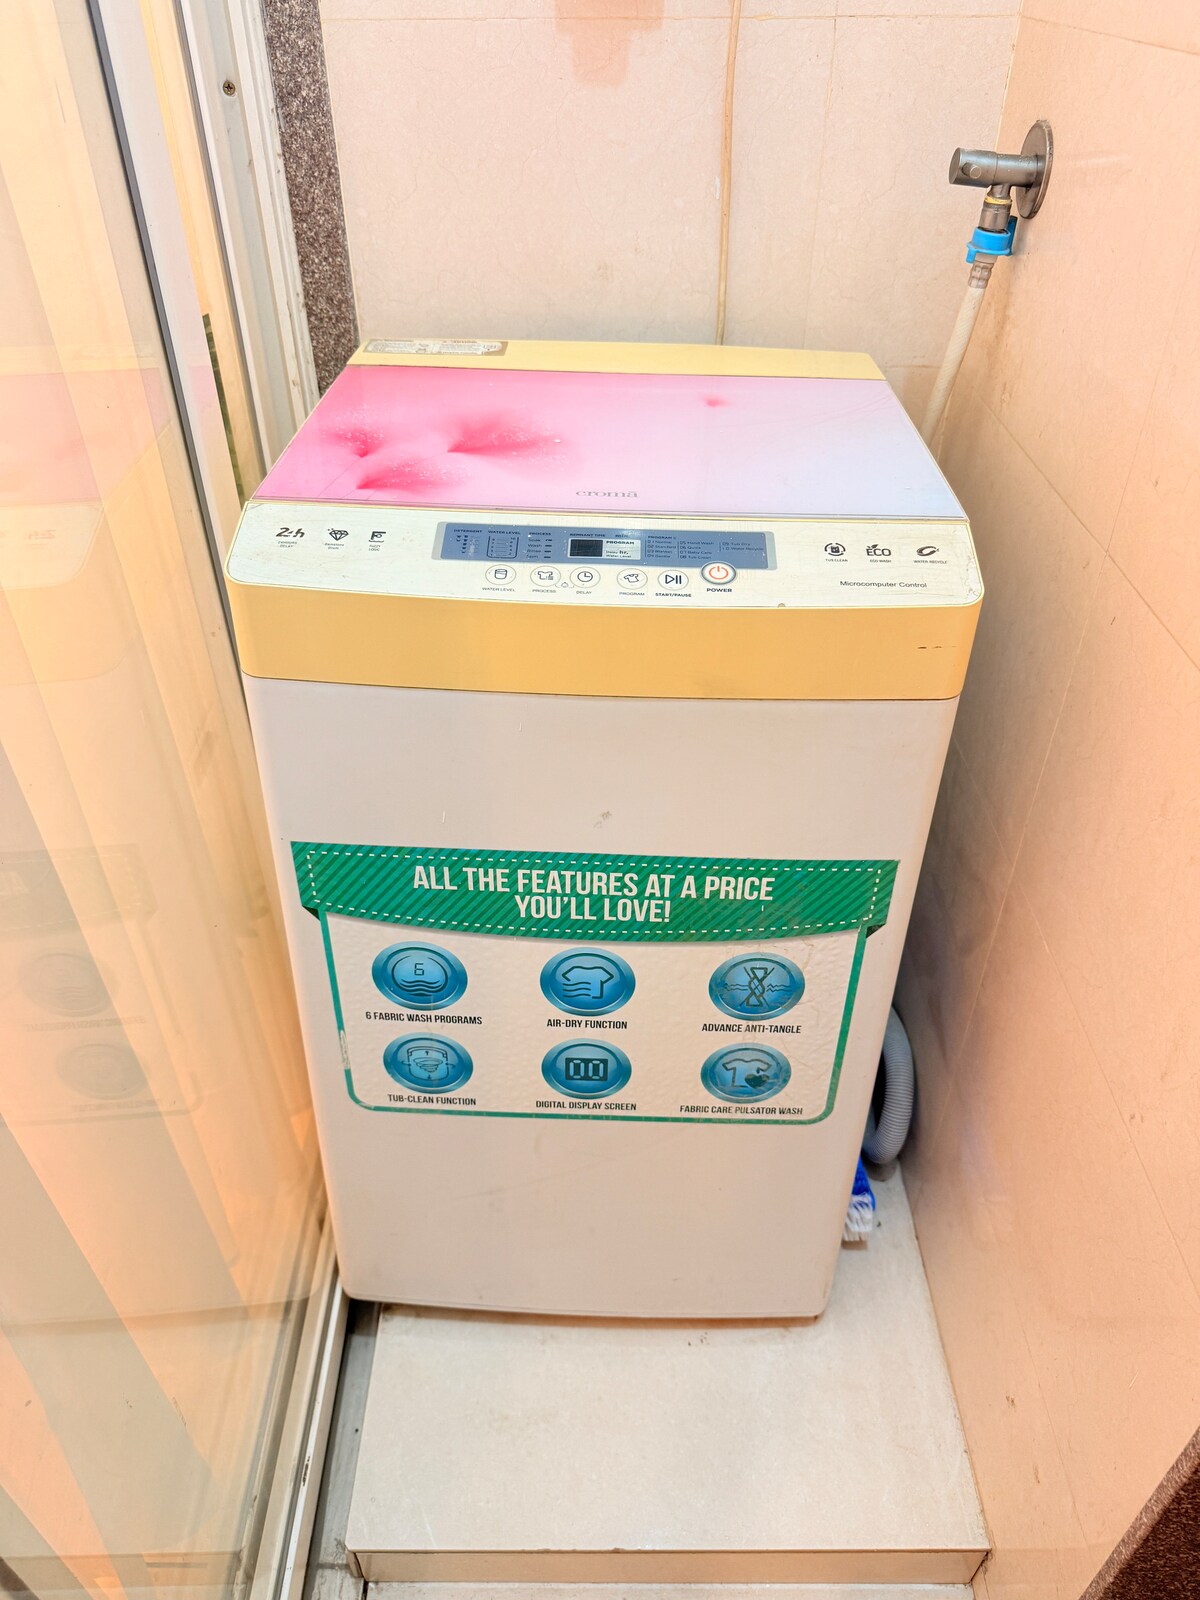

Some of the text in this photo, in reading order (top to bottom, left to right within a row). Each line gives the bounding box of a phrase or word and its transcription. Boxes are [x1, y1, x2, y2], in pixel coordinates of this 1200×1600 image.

[866, 548, 892, 557] ECO
[413, 865, 776, 901] ALL THE FEATURES AT A PRICE
[514, 895, 671, 923] YOU'LL LOVE!
[365, 1011, 482, 1025] 6 FABRIC WASH PROGRAMS
[546, 1018, 628, 1030] AIR-DRY FUNCTION
[701, 1023, 802, 1034] ADVANCE ANTI-TANGLE
[387, 1094, 477, 1106] TUB-CLEAN FUNCTION
[535, 1100, 637, 1111] DIGITAL DISPLAY SCREEN
[680, 1104, 803, 1115] FABRIC CARE PULSATOR WASH
